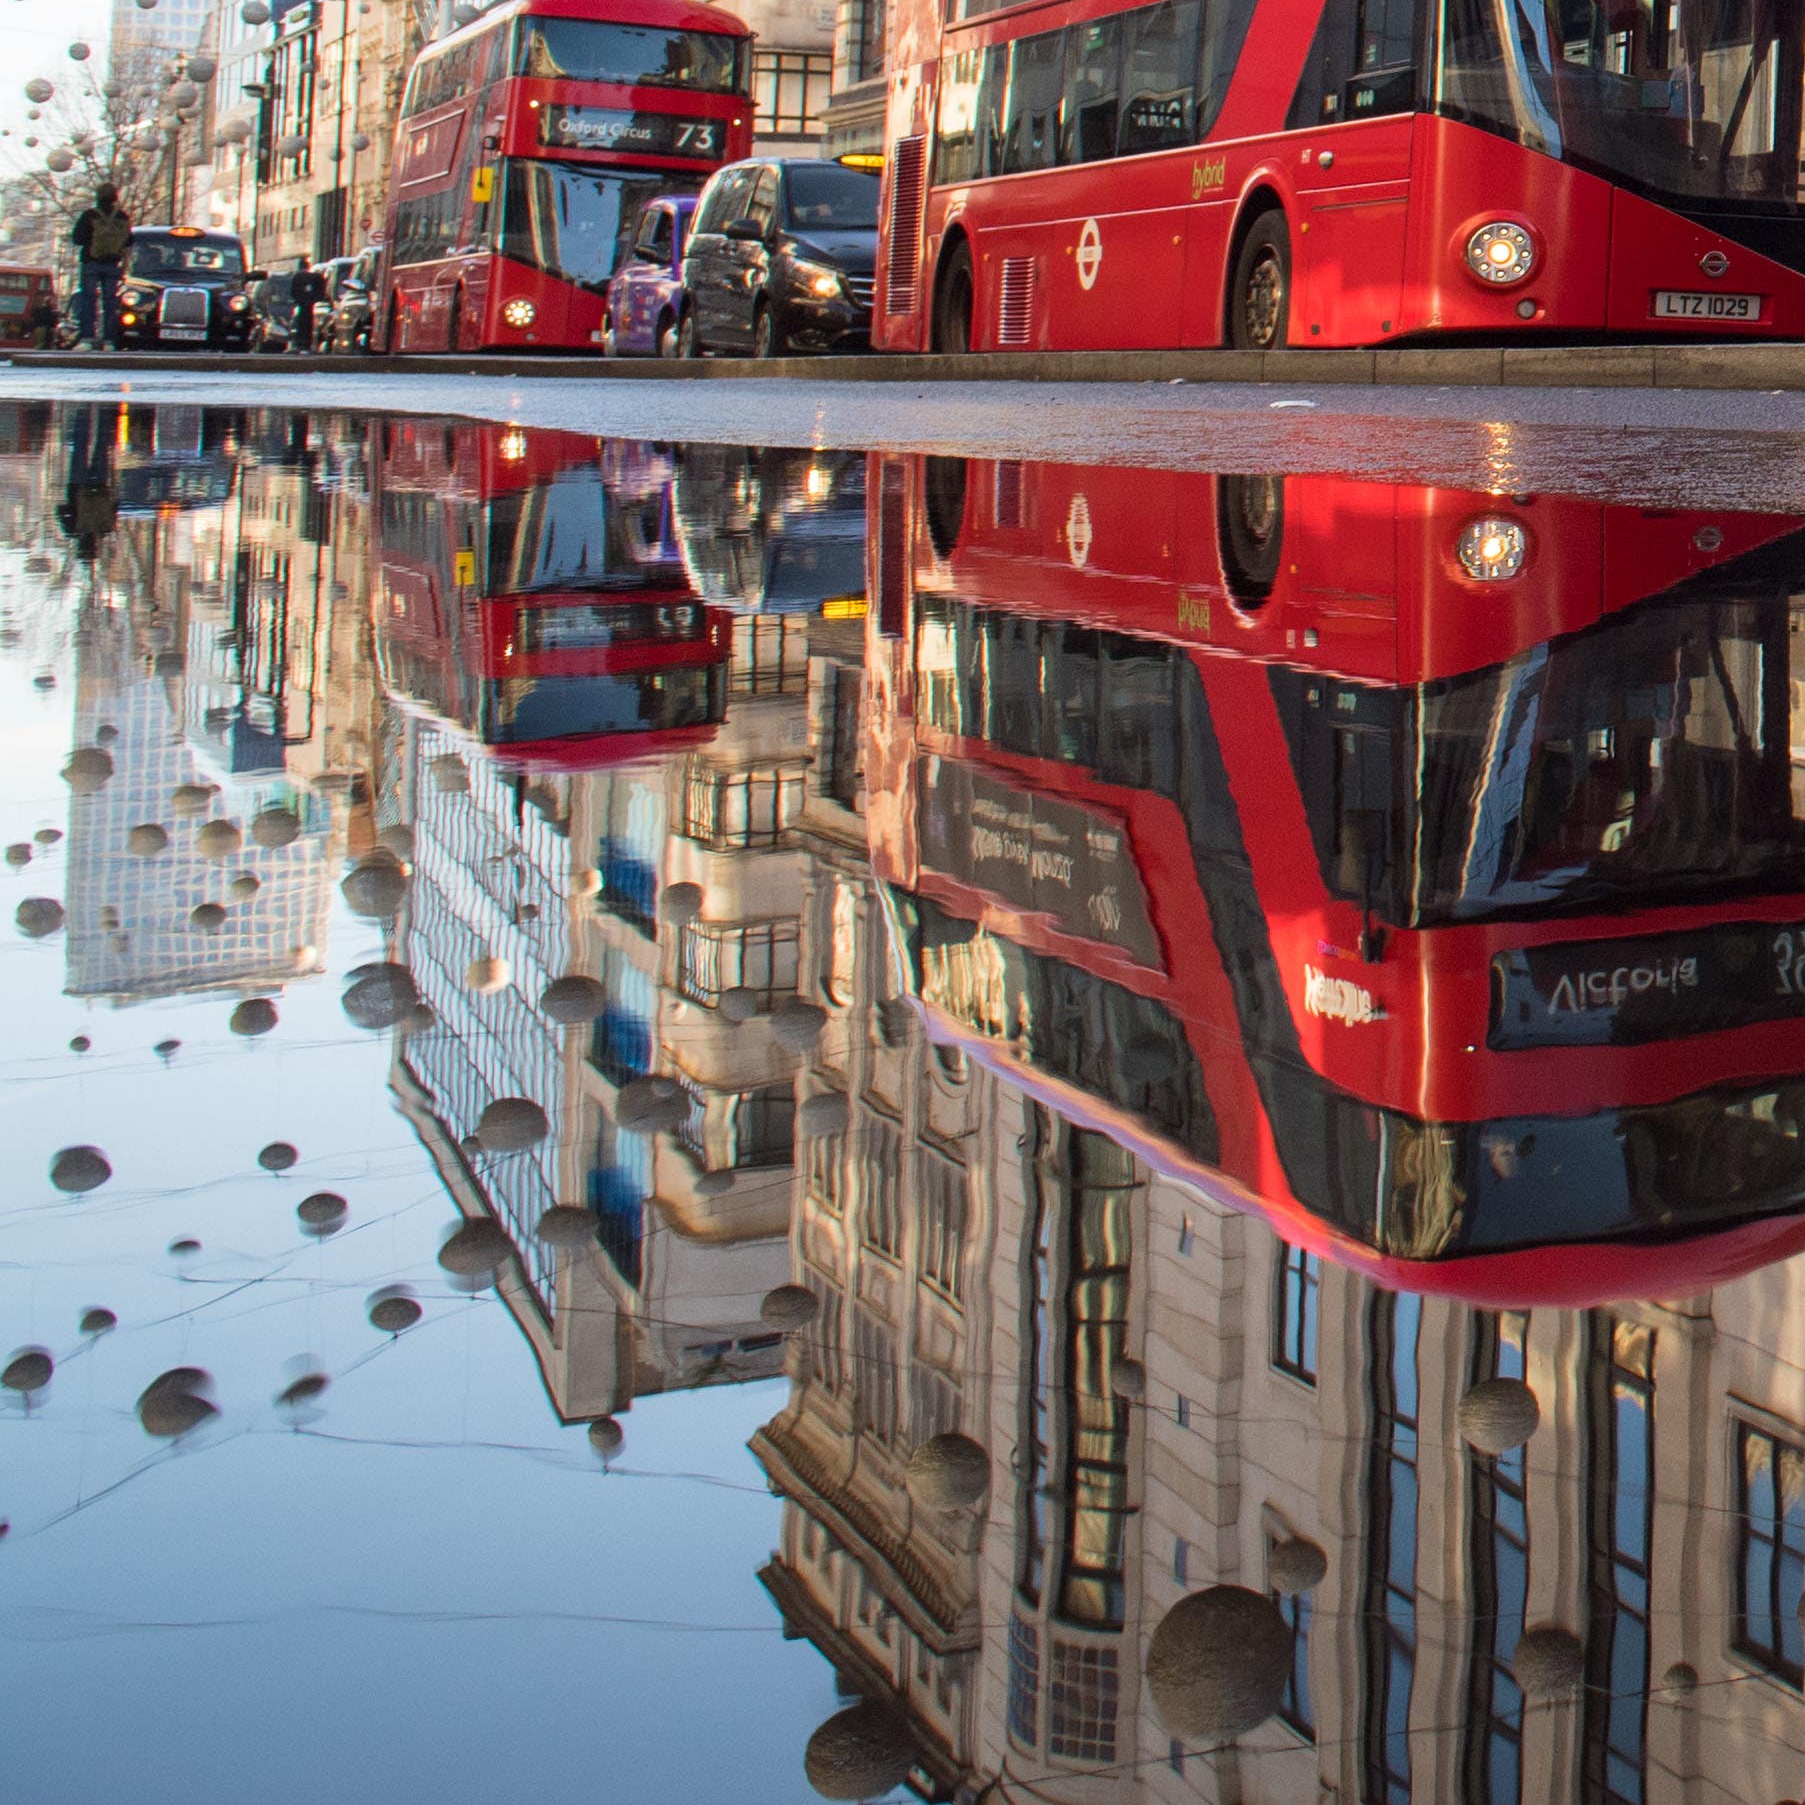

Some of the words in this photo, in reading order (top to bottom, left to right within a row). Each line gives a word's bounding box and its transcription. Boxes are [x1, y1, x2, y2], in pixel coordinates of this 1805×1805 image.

[558, 118, 607, 136] Oxford
[610, 121, 652, 140] Circus
[675, 122, 714, 150] 73
[1192, 156, 1226, 200] hybrid
[1666, 295, 1703, 314] LTZ
[1707, 297, 1749, 316] 1029
